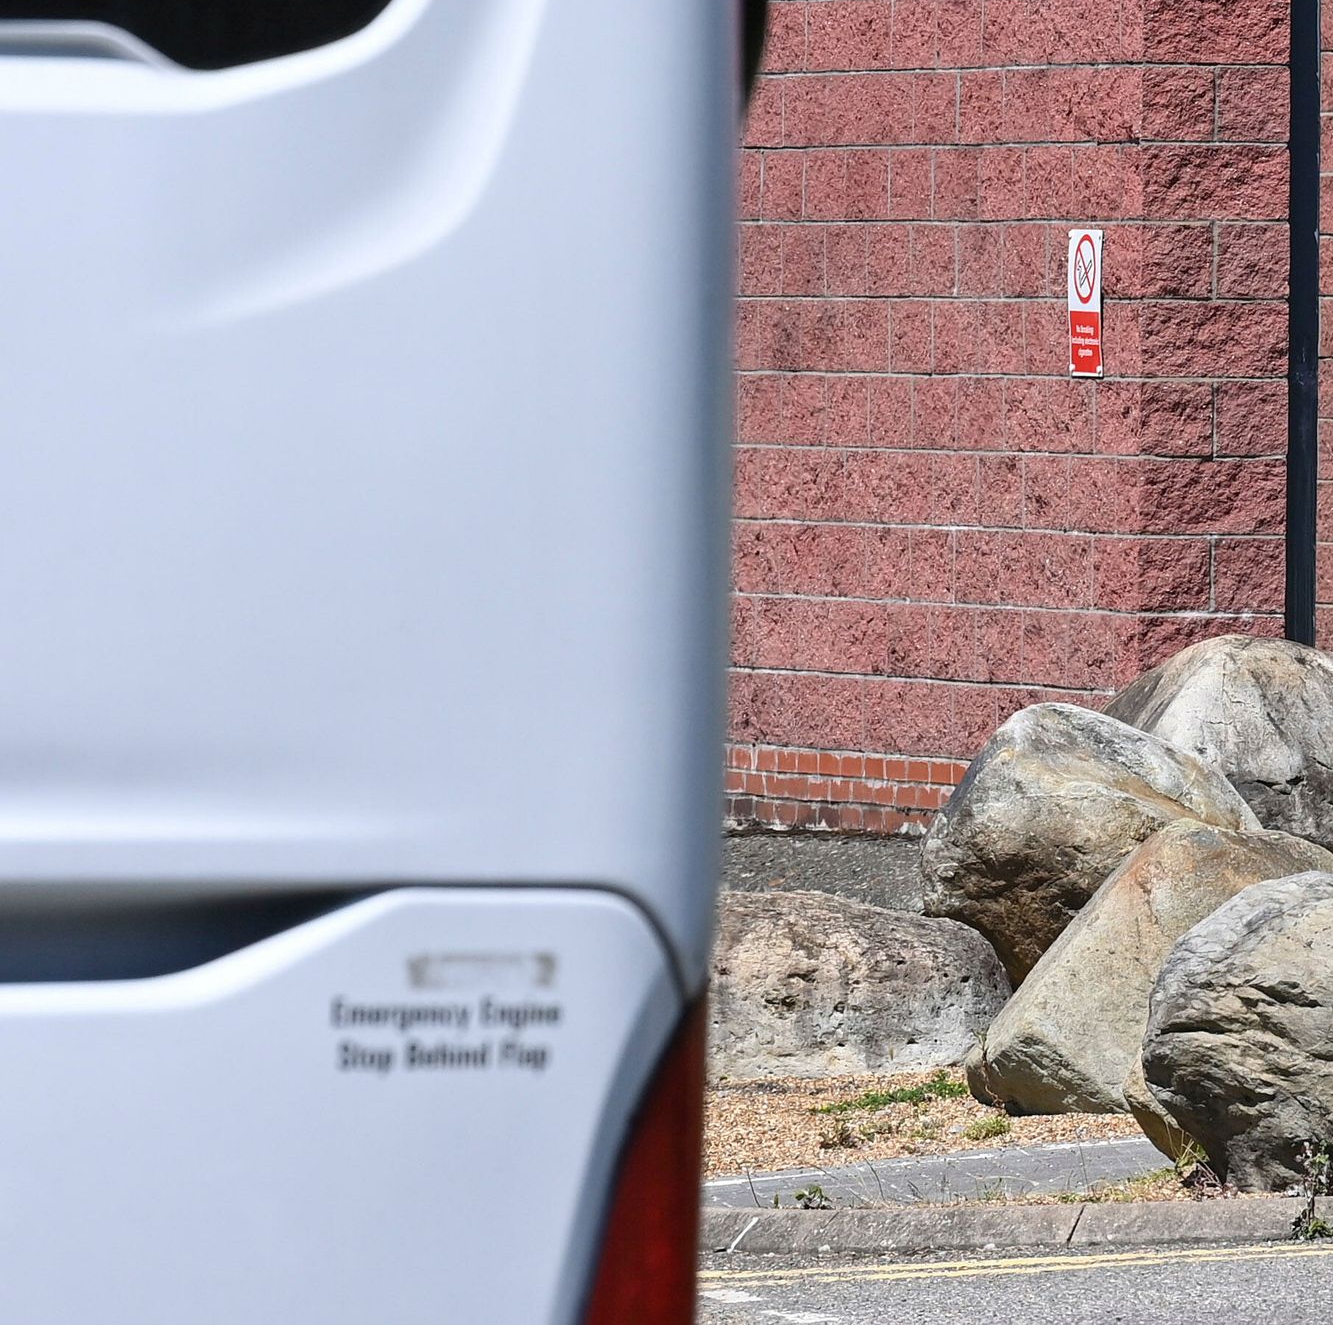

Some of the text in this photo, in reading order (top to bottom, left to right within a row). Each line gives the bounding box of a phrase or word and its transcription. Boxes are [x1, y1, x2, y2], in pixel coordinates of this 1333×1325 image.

[330, 996, 562, 1031] Emergency Engine
[338, 1040, 393, 1075] Stop
[406, 1040, 489, 1071] Behind
